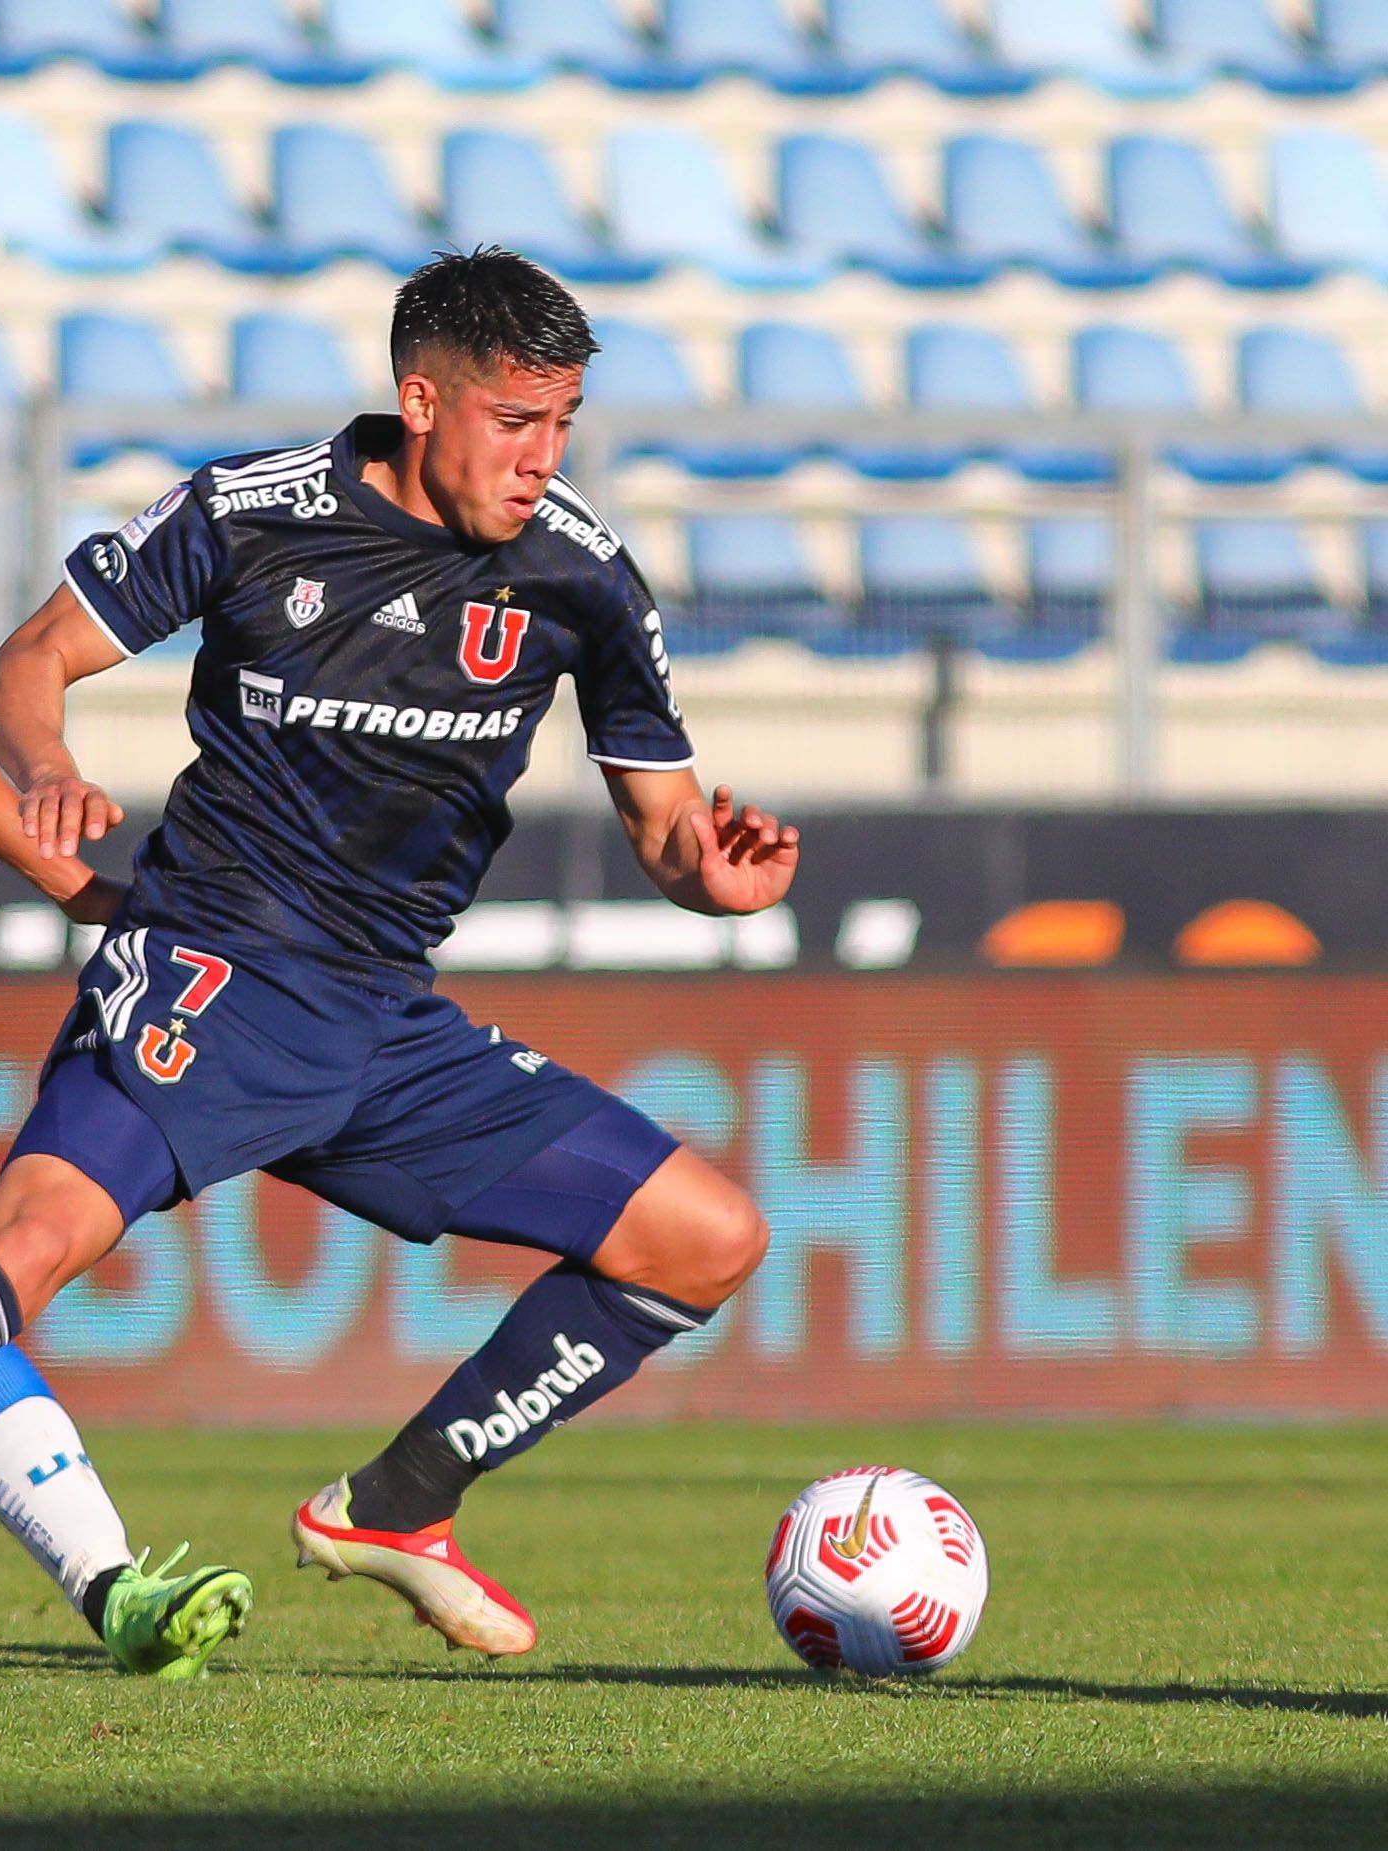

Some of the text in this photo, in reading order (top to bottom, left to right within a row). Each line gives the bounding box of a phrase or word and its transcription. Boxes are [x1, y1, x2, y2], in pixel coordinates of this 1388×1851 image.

[207, 471, 328, 520] DIRECTV
[292, 493, 339, 520] GO
[294, 602, 314, 619] U
[371, 611, 428, 635] adidas
[457, 602, 531, 684] U
[246, 688, 523, 741] BR PETROBRAS
[170, 945, 233, 1018] 7
[134, 1023, 197, 1085] U
[444, 1331, 607, 1463] Dolorub
